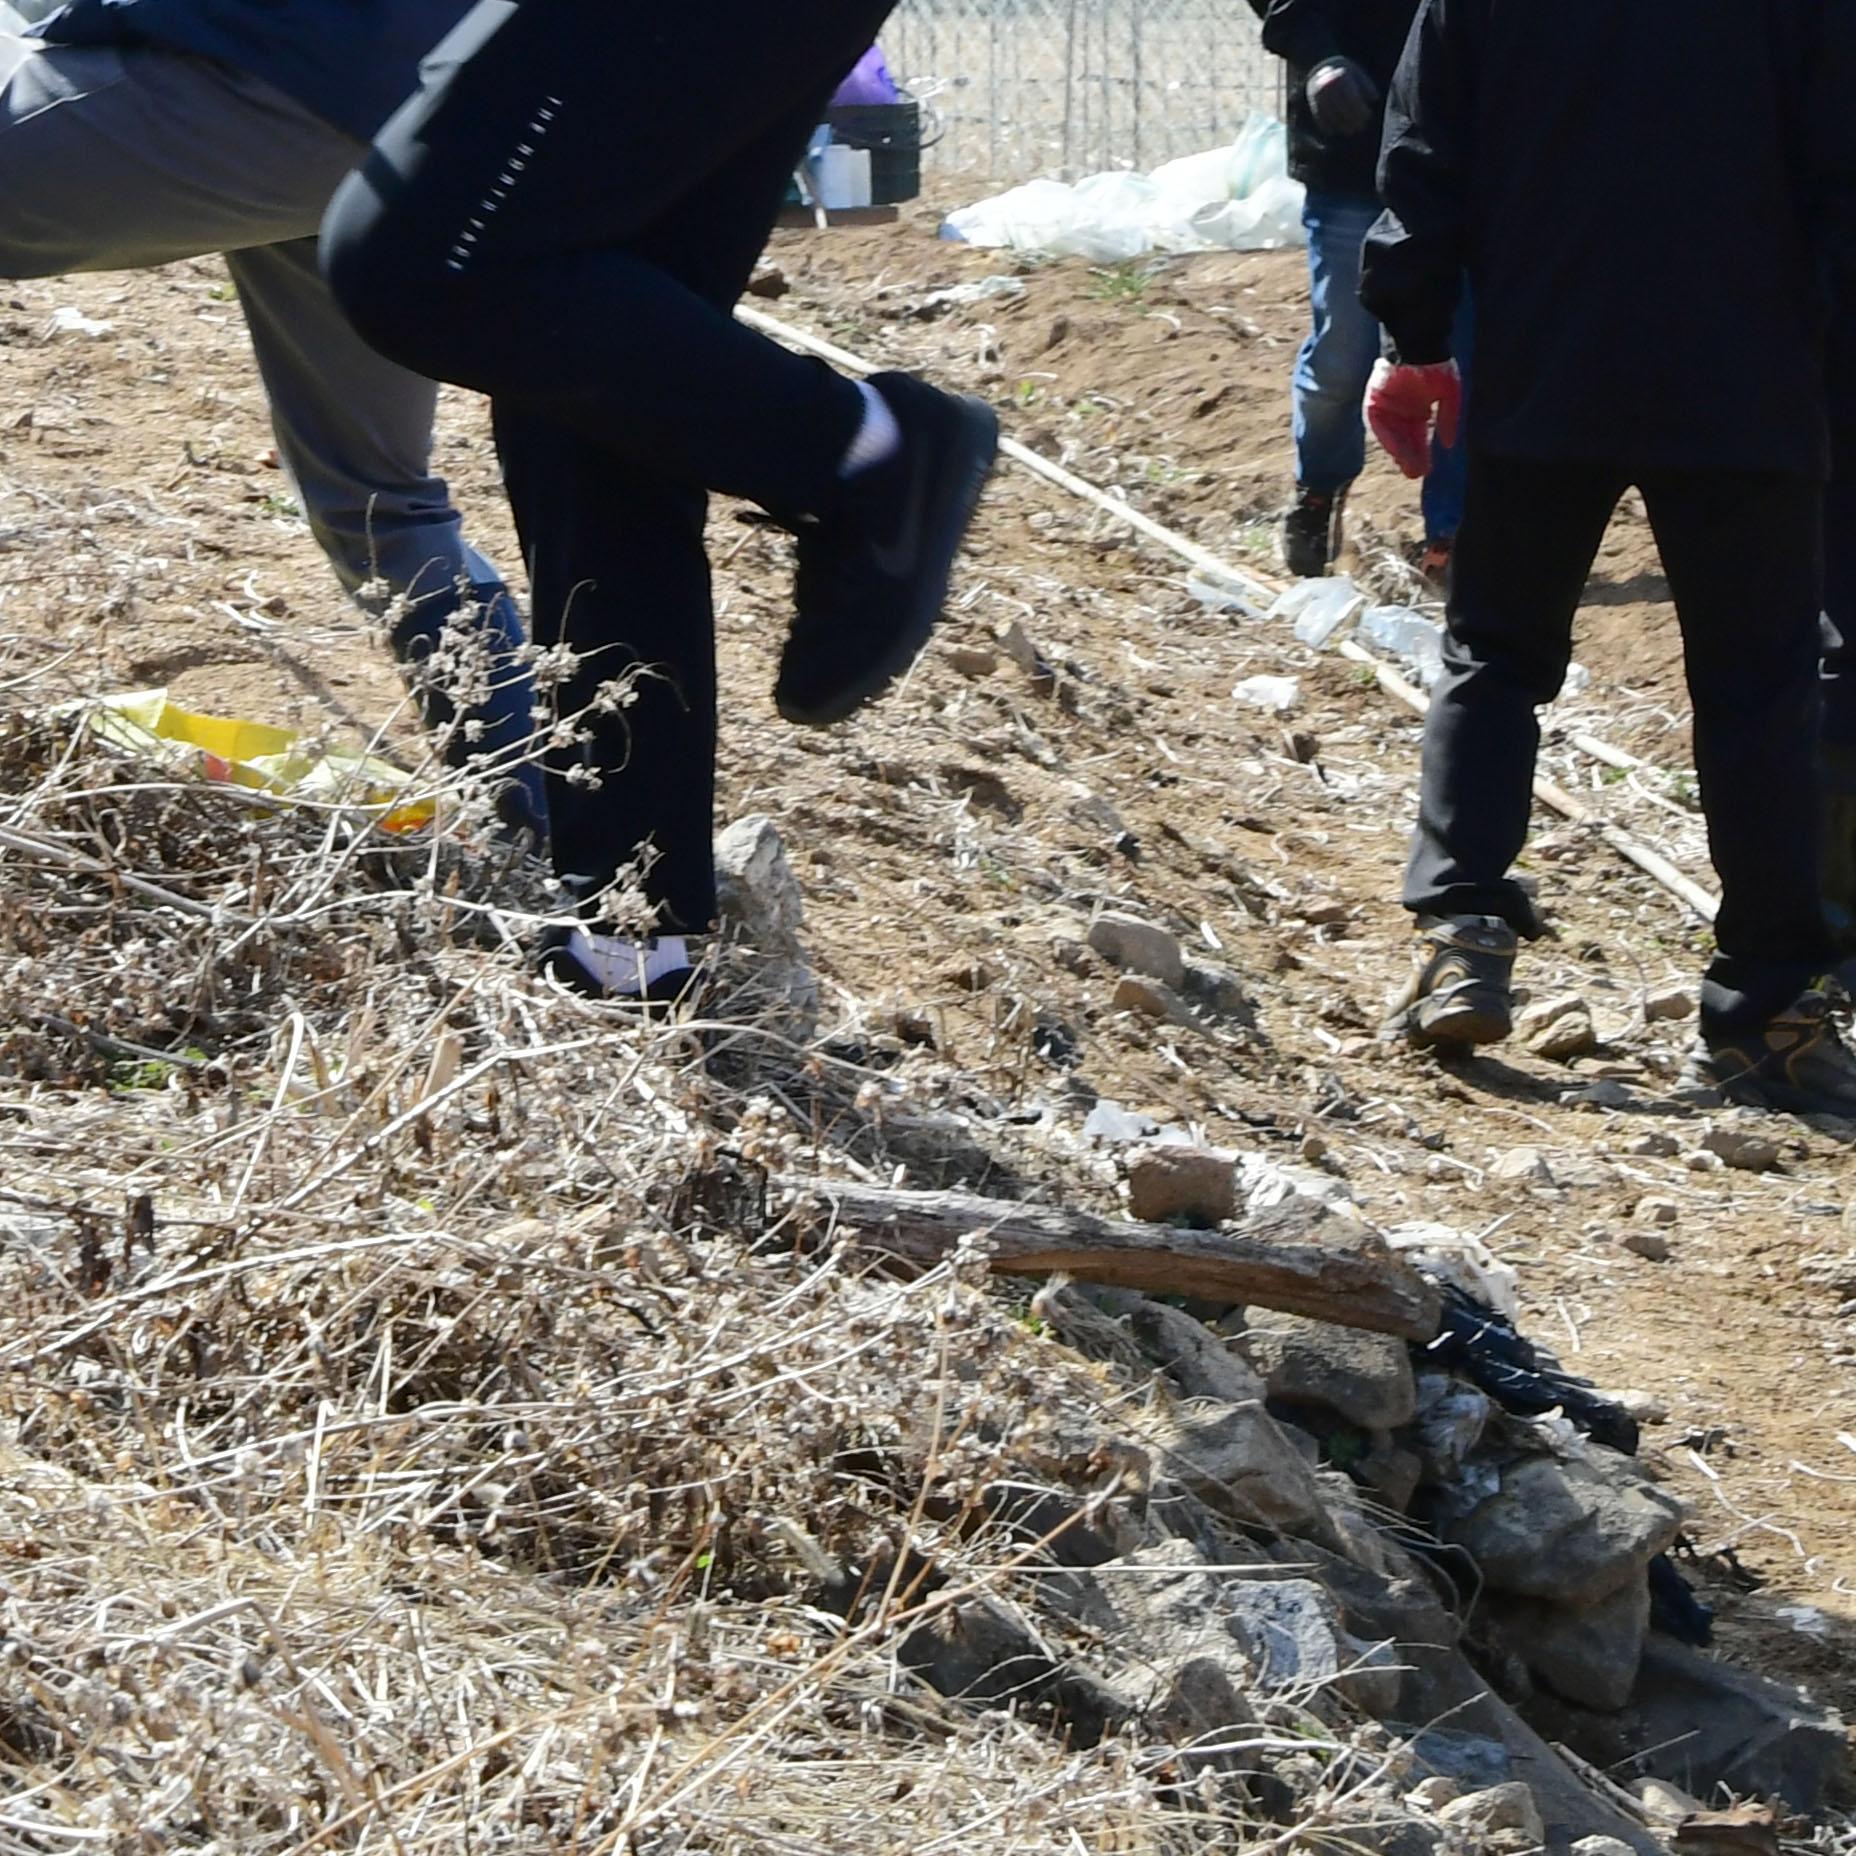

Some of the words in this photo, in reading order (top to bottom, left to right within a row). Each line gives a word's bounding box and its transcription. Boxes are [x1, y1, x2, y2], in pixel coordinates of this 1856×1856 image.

[530, 96, 563, 134] THE
[481, 142, 535, 212] NORTH
[447, 217, 486, 271] FACE
